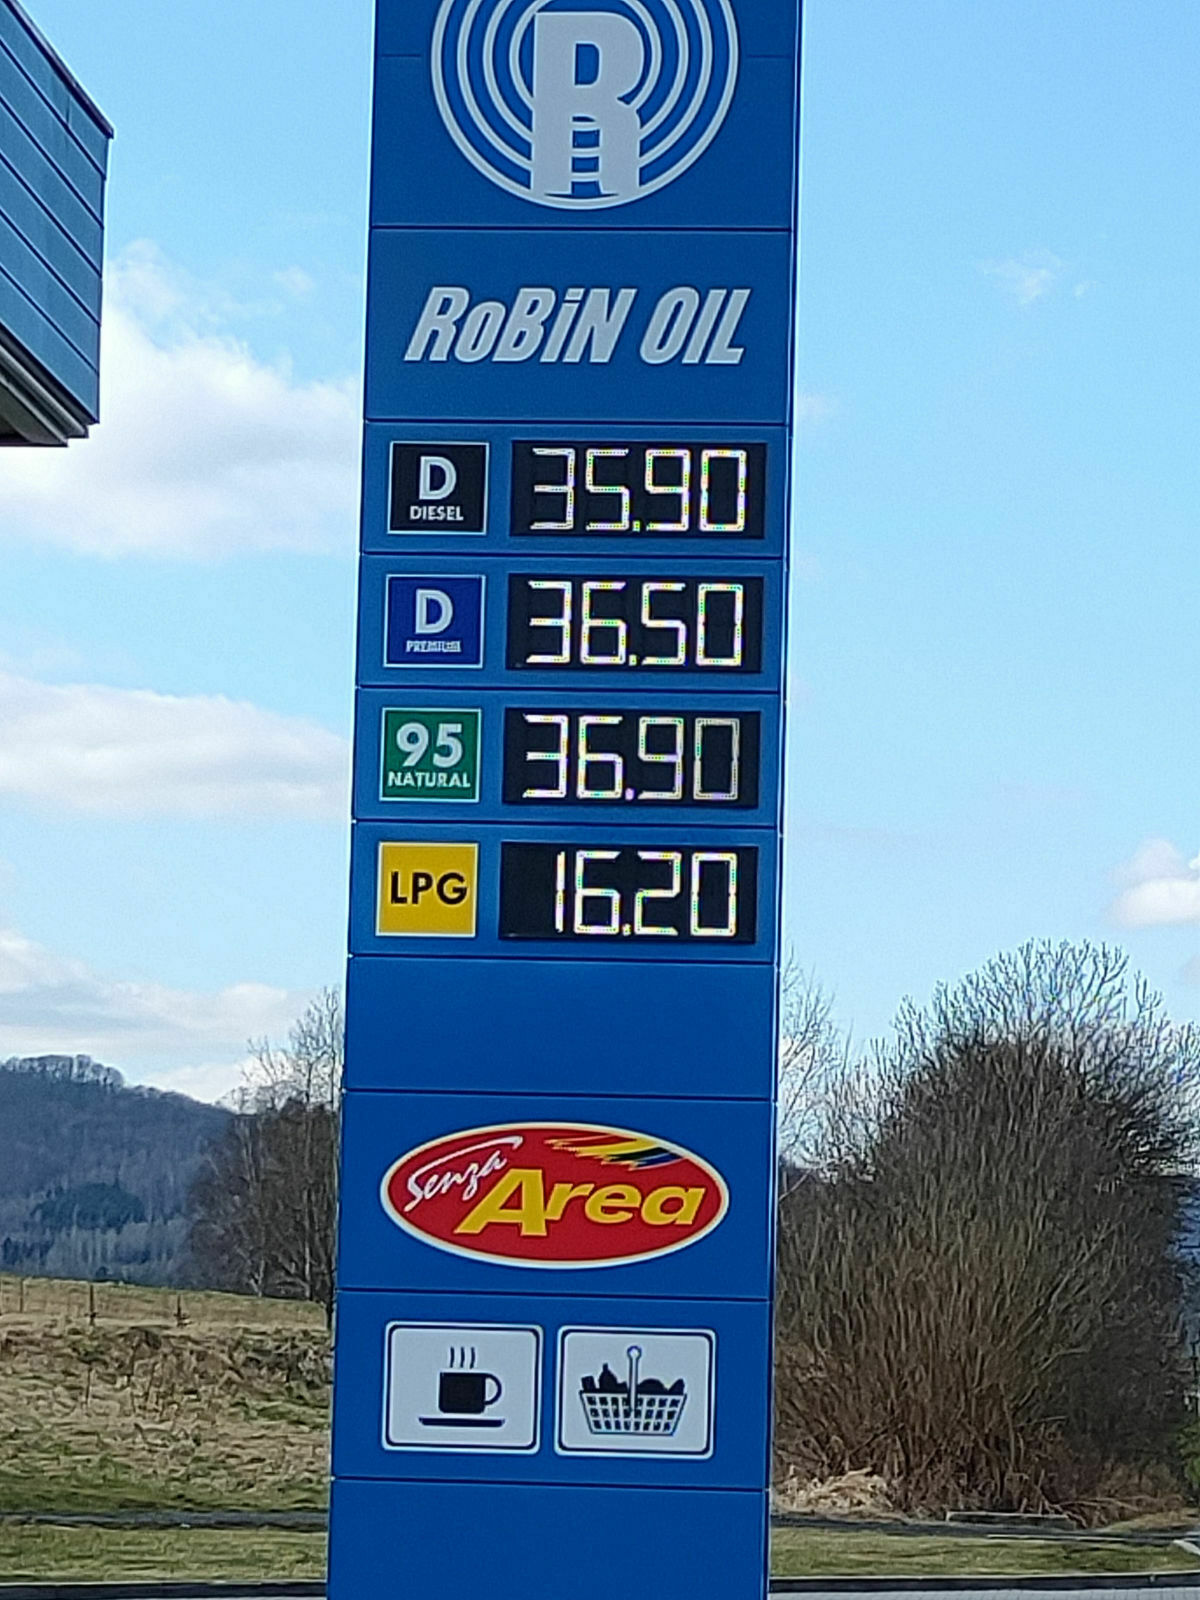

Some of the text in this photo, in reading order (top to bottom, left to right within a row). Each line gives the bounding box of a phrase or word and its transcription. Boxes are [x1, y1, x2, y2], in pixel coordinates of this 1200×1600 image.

[640, 286, 751, 364] OIL
[419, 455, 457, 500] D
[530, 447, 747, 532] 35.90
[409, 505, 464, 521] DIESEL
[415, 588, 454, 635] D
[526, 580, 744, 667] 36.50
[396, 722, 464, 769] 95
[522, 713, 740, 801] 36.90
[387, 771, 471, 789] NATURAL
[390, 871, 468, 906] LPG
[554, 850, 738, 937] 16.20
[403, 1135, 706, 1237] Senza Area
